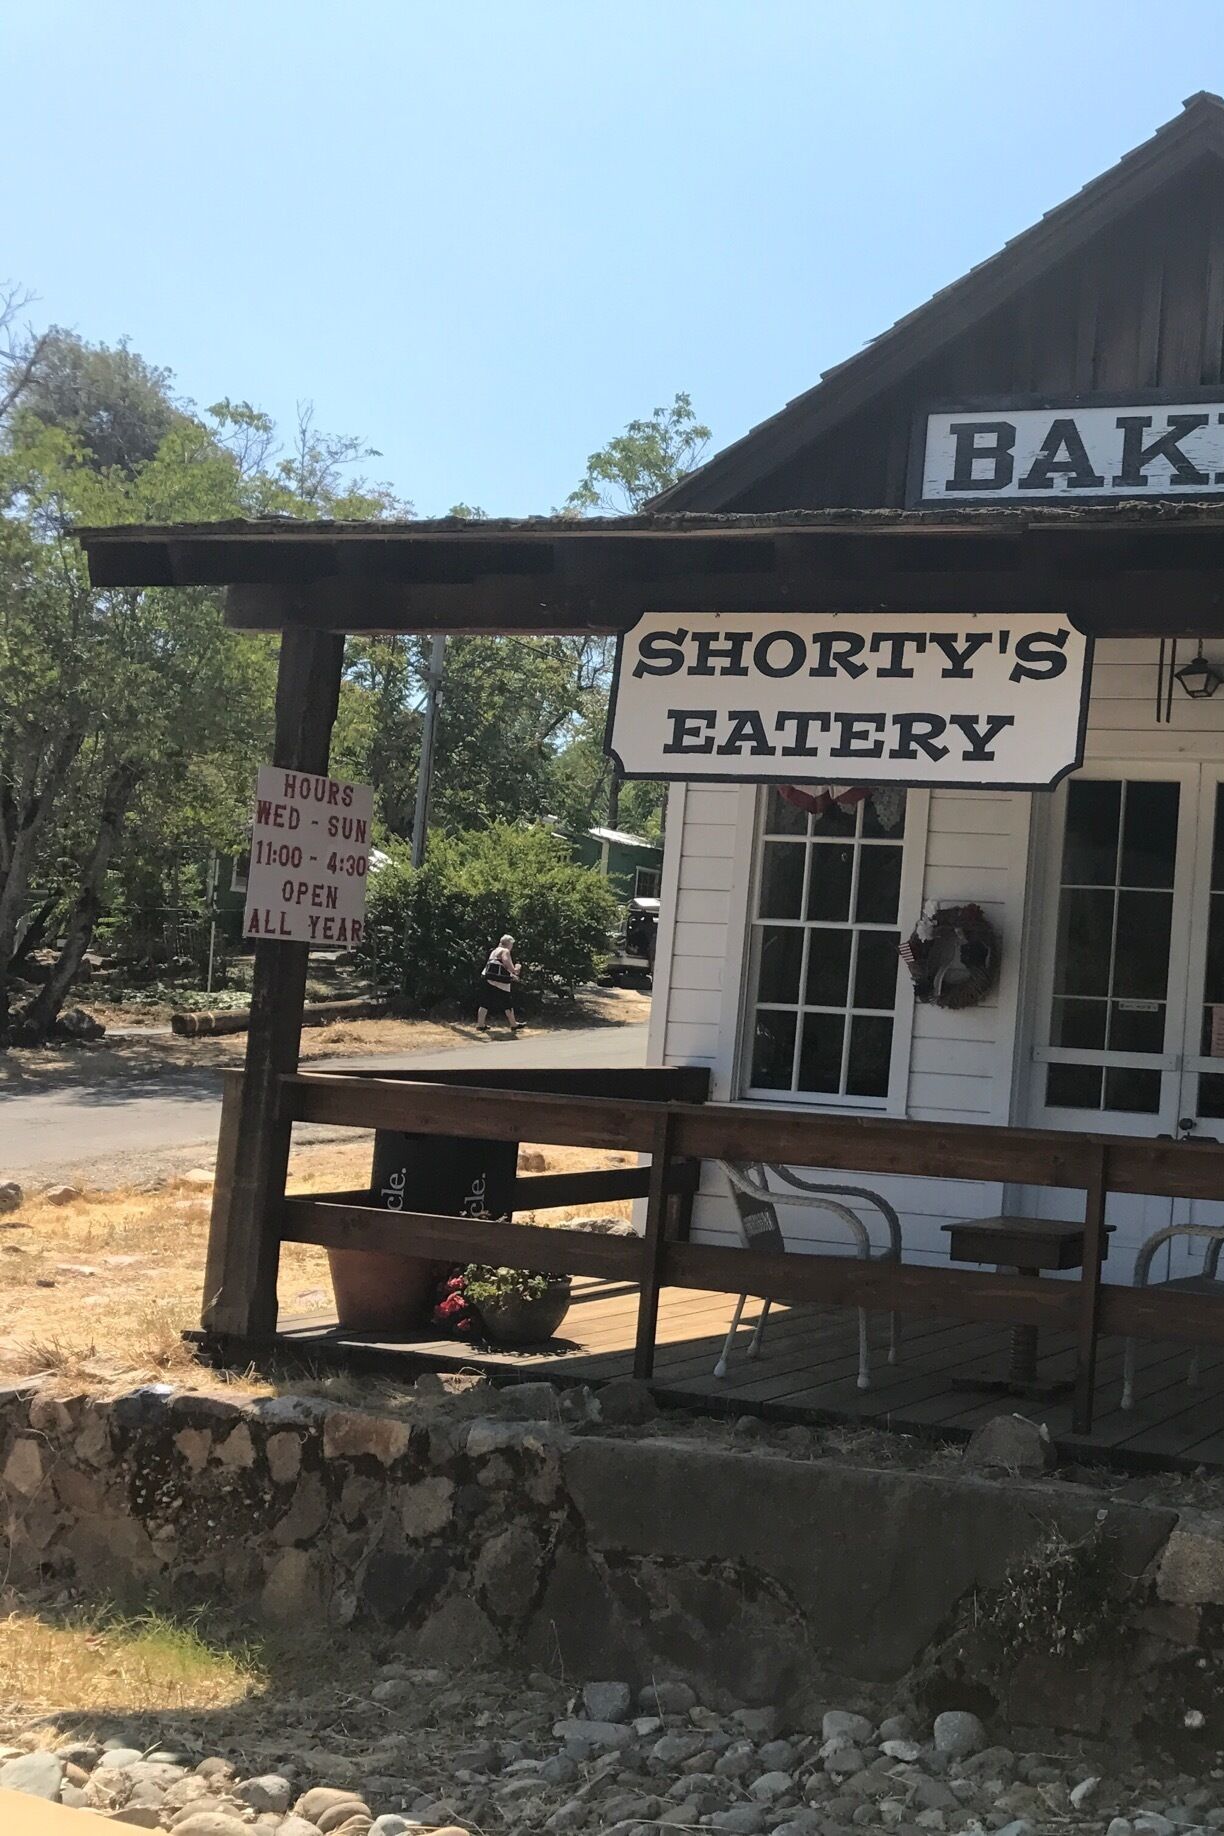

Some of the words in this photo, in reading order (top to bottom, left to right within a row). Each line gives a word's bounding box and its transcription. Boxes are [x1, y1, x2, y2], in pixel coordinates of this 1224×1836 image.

[632, 628, 1071, 684] SHORTY'S
[663, 709, 1015, 763] EATERY
[284, 773, 354, 807] HOURS
[256, 800, 301, 830] WED
[328, 815, 367, 844] SUN
[256, 840, 303, 869] 11:00
[326, 851, 367, 877] 4:30
[281, 880, 339, 910] OPEN
[248, 908, 292, 936] ALL
[309, 915, 363, 942] YEAR
